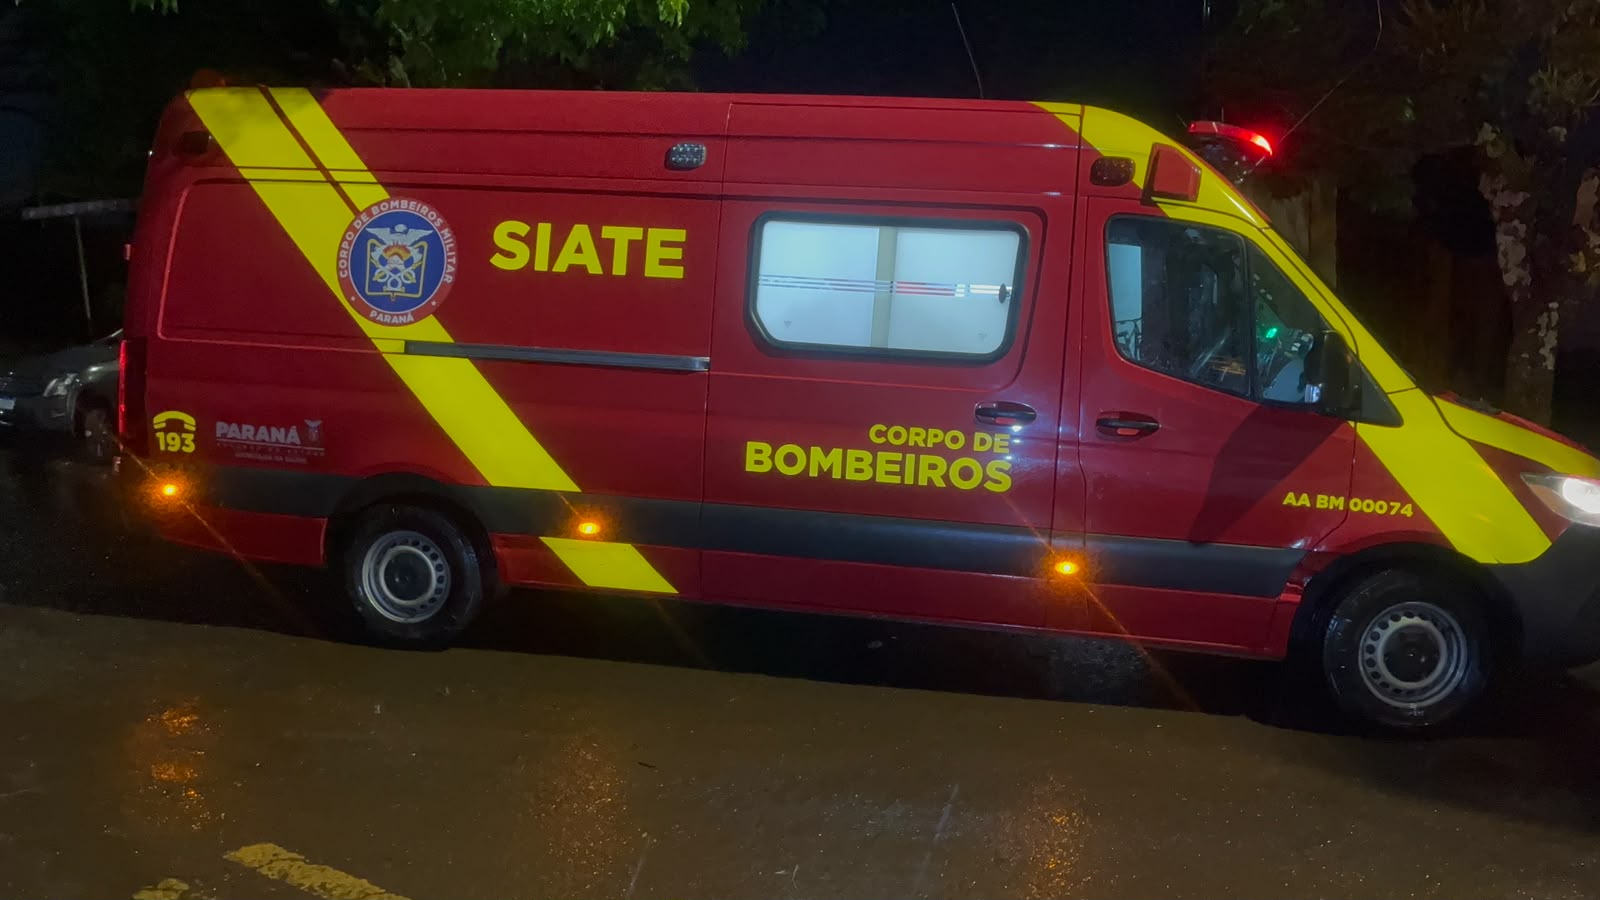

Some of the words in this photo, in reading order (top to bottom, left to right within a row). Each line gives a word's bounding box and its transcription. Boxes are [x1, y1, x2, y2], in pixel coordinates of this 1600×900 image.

[338, 231, 354, 278] CORPO
[353, 214, 369, 229] DE
[371, 200, 443, 227] BOMBEIROS
[441, 228, 456, 284] MILITAR
[489, 220, 687, 279] SIATE
[369, 310, 415, 324] PARANÁ
[155, 431, 196, 453] 193
[215, 420, 301, 444] PARANÁ
[869, 424, 965, 450] CORPO
[973, 432, 1010, 454] DE
[745, 441, 1012, 493] BOMBEIROS
[1282, 491, 1311, 507] AA
[1316, 494, 1345, 511] BM
[1349, 497, 1414, 518] 00074
